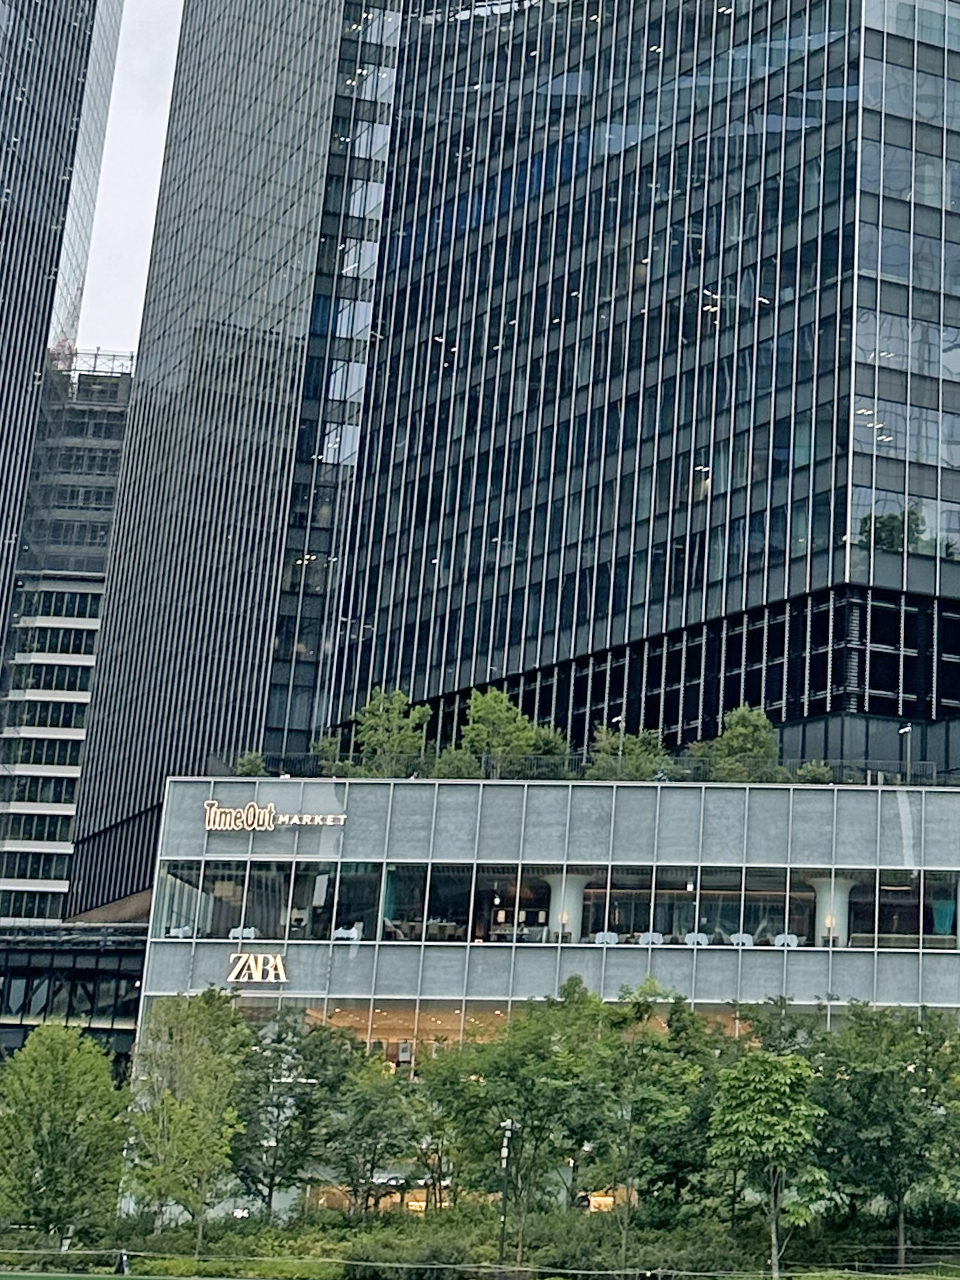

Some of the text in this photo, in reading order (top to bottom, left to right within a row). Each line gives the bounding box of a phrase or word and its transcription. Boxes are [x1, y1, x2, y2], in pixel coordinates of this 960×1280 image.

[203, 800, 348, 831] Time Out MARKET
[226, 953, 290, 983] ZARA
